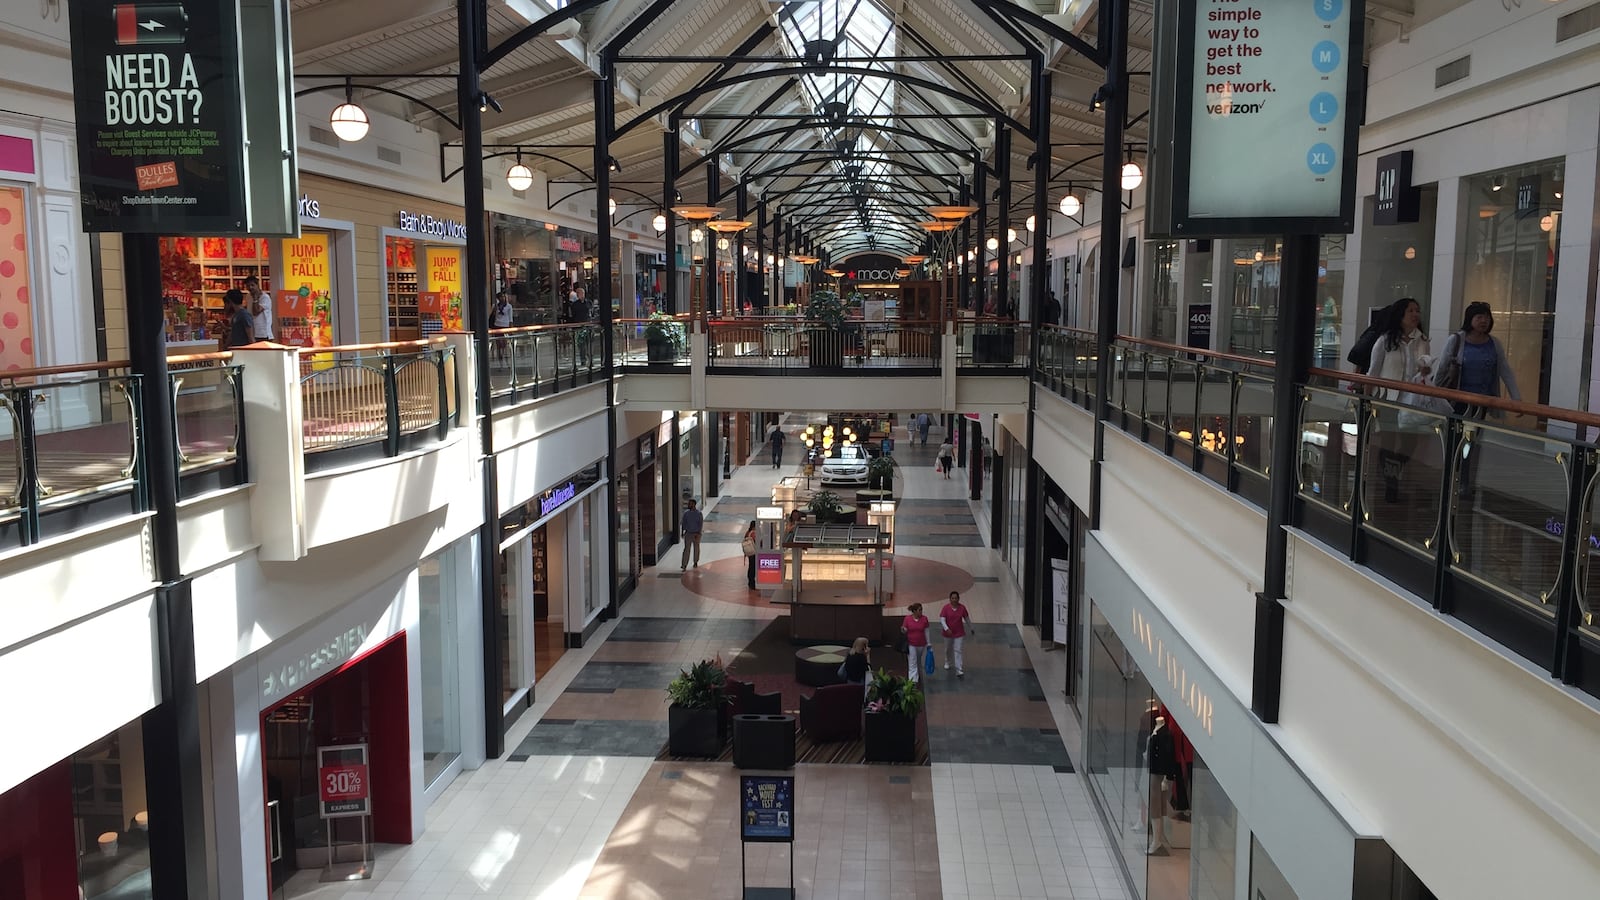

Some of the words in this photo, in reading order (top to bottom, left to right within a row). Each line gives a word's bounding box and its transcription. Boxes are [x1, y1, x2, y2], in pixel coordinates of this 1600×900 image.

[1208, 7, 1262, 24] simple
[1208, 28, 1240, 41] way
[1243, 26, 1259, 39] to
[1207, 44, 1233, 60] get
[1236, 43, 1262, 57] the
[1319, 50, 1332, 63] M
[105, 53, 171, 90] NEED
[179, 53, 199, 89] A
[1206, 62, 1242, 76] best
[1206, 79, 1276, 94] network.
[104, 88, 203, 125] BOOST?
[1206, 101, 1260, 115] verizon
[1319, 102, 1327, 114] L
[142, 129, 167, 138] Services
[1312, 152, 1329, 165] XL
[139, 165, 175, 178] DULLES
[400, 208, 420, 232] Bath
[420, 214, 428, 233] &
[426, 215, 446, 240] Body
[291, 244, 323, 258] JUMP
[432, 256, 457, 268] JUMP
[292, 263, 323, 277] FALL!
[433, 271, 457, 282] FALL!
[857, 266, 901, 283] macy's
[285, 295, 299, 310] $7
[541, 482, 575, 516] bareMinerals
[760, 559, 780, 567] FREE
[326, 771, 361, 794] 30%
[348, 784, 361, 793] OFF
[761, 800, 774, 809] FEST
